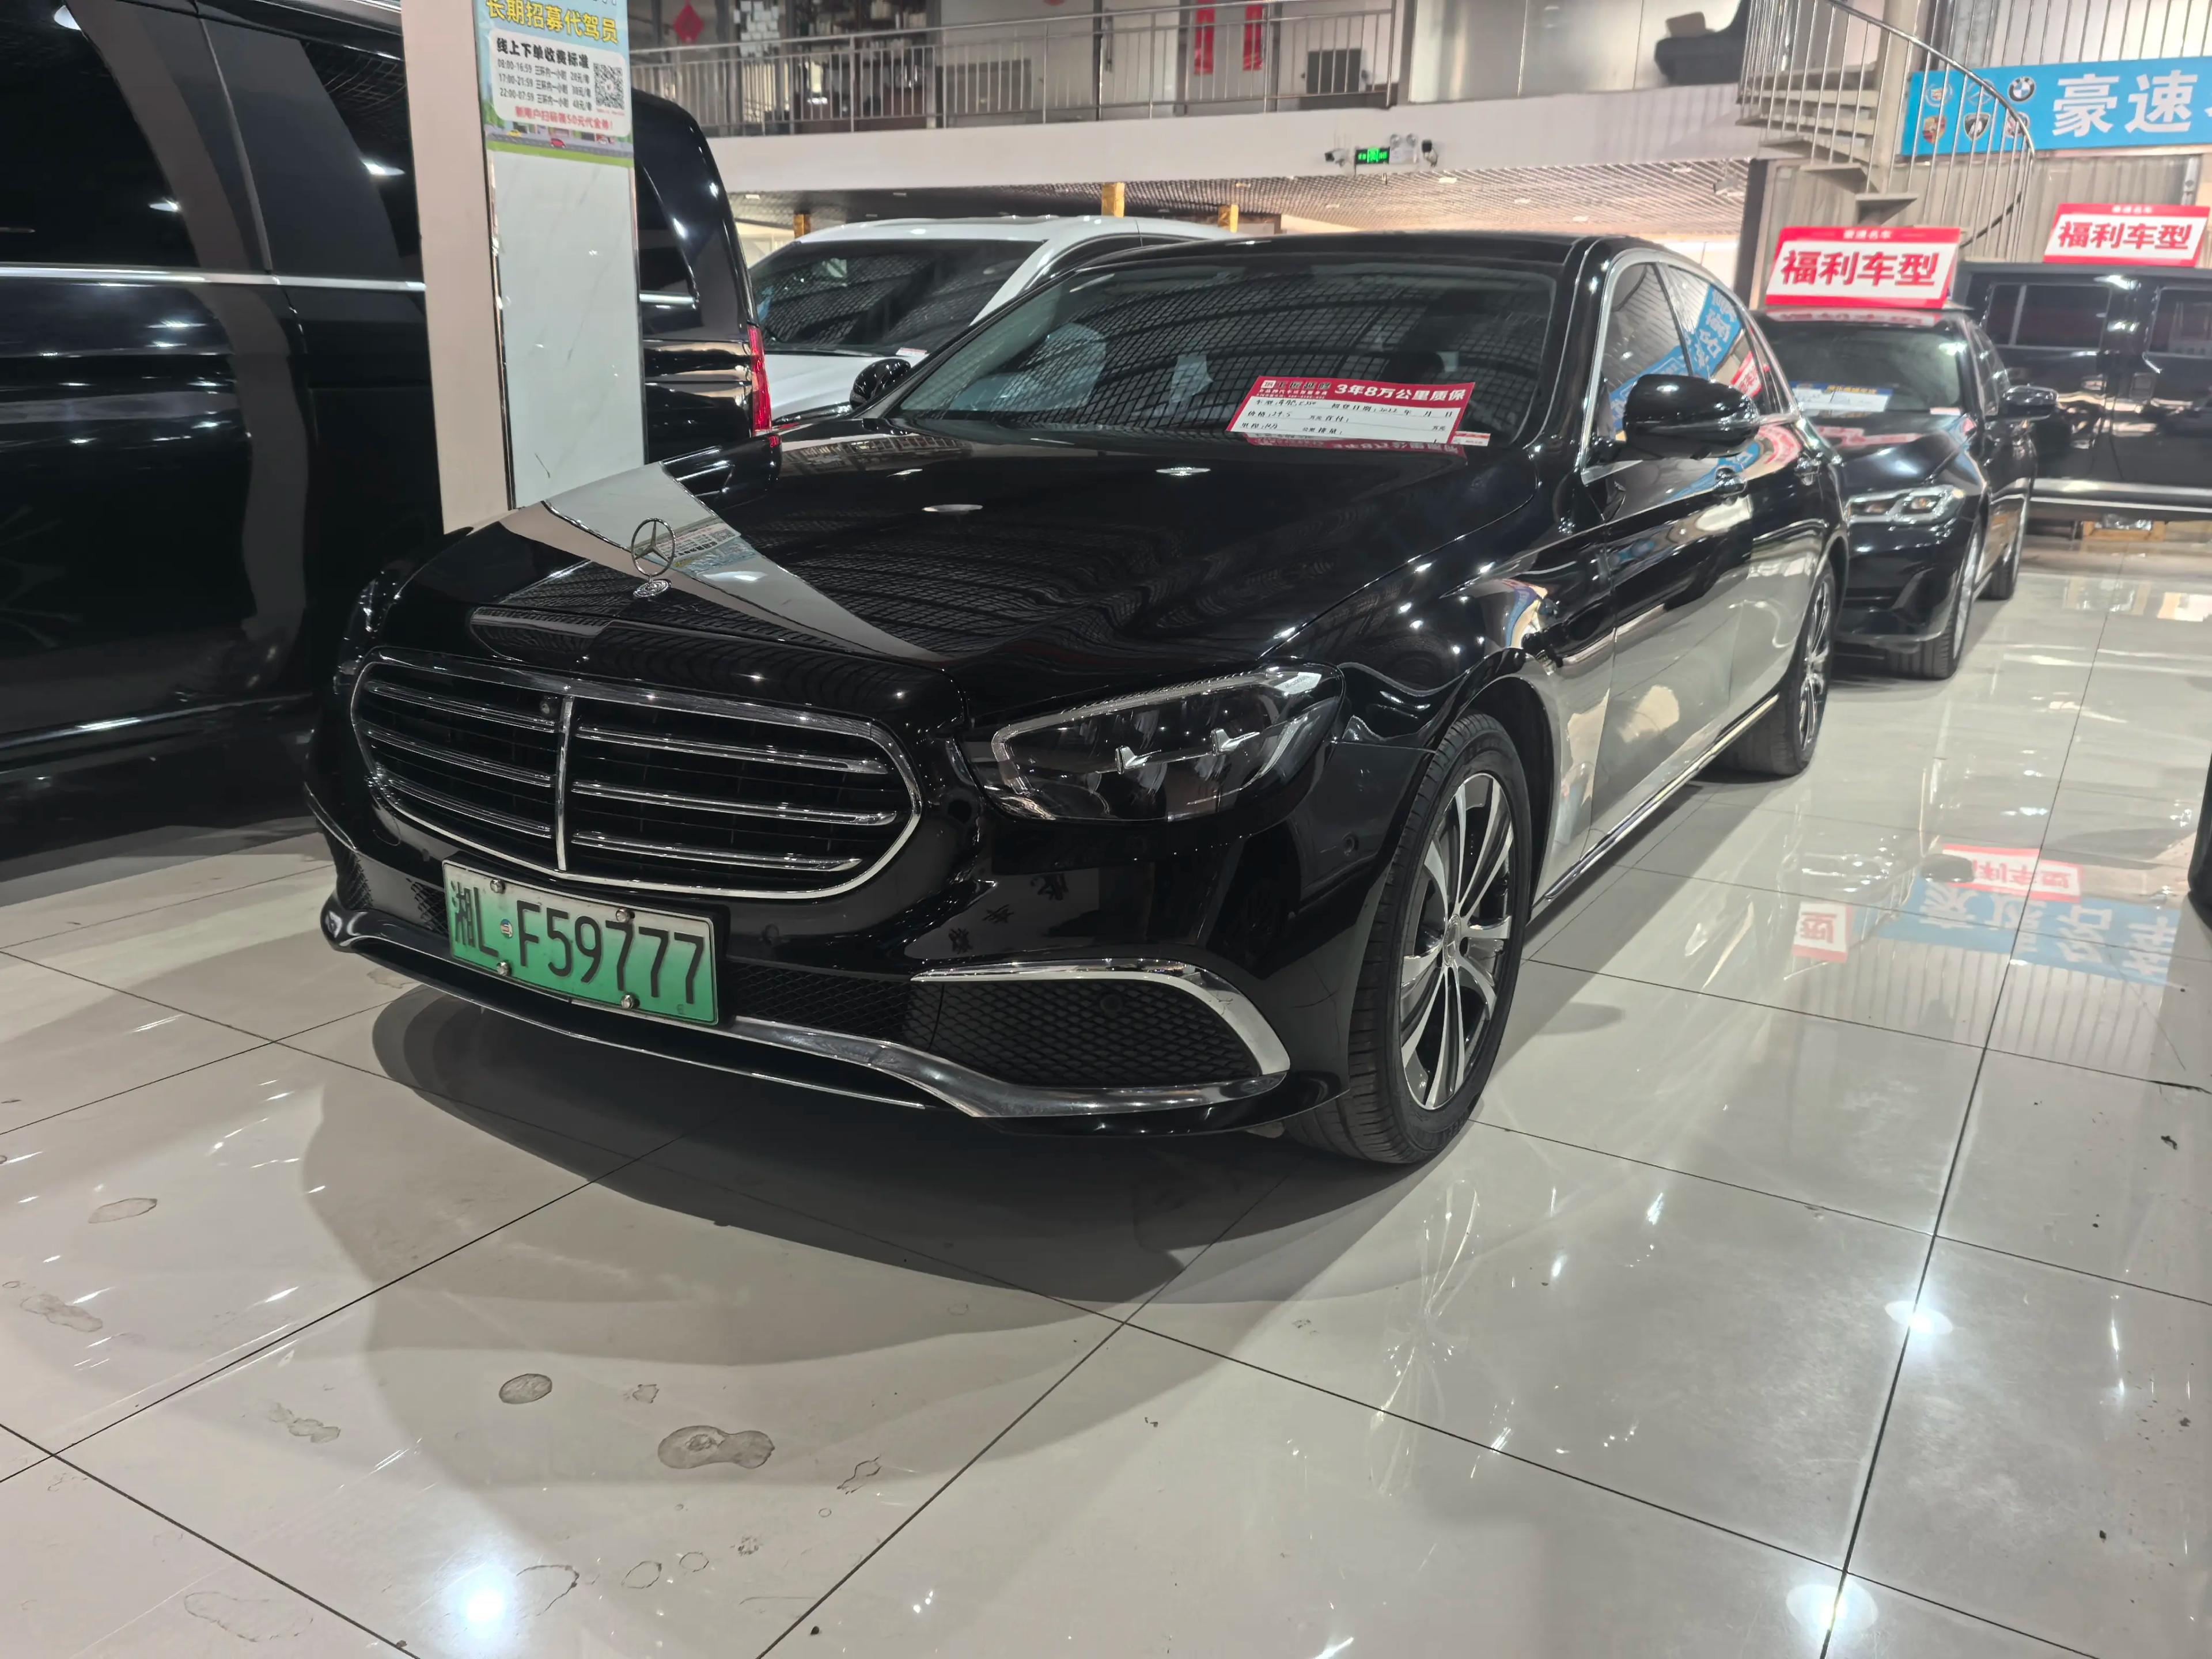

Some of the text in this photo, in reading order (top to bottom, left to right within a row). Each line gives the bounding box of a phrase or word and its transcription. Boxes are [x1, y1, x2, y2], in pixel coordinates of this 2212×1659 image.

[486, 0, 619, 44] 长期招募代驾员
[497, 37, 589, 69] 线上下单收费标准
[2052, 69, 2212, 138] 豪速
[2058, 221, 2192, 249] 福利车型
[1781, 250, 1940, 286] 福利车型
[1335, 384, 1466, 402] 3年8万公里质保
